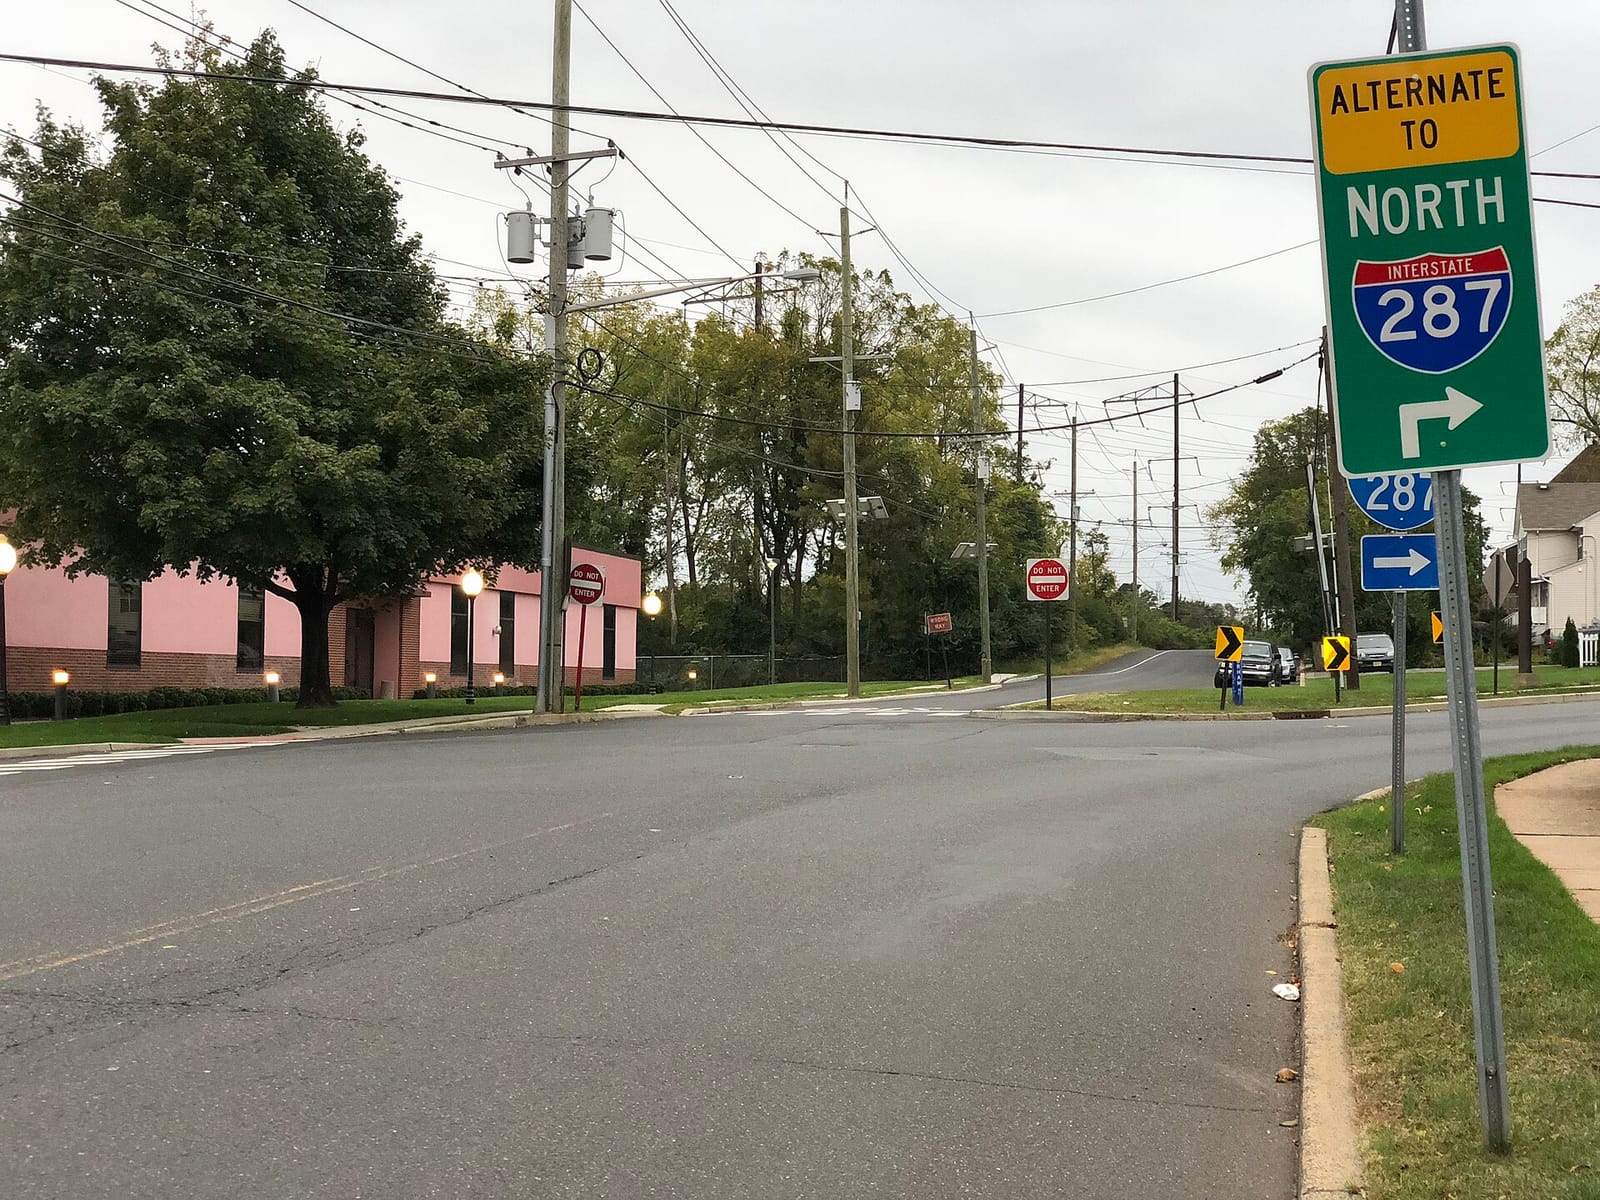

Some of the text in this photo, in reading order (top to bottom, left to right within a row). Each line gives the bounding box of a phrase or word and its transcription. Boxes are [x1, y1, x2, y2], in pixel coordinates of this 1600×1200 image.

[1331, 68, 1505, 115] ALTERNATE
[1401, 118, 1438, 150] TO
[1347, 176, 1505, 238] NORTH
[1388, 258, 1474, 280] INTERSTATE
[1377, 278, 1502, 343] 287
[1366, 473, 1433, 511] 287
[574, 570, 599, 580] DO NOT
[574, 588, 595, 598] ENTER
